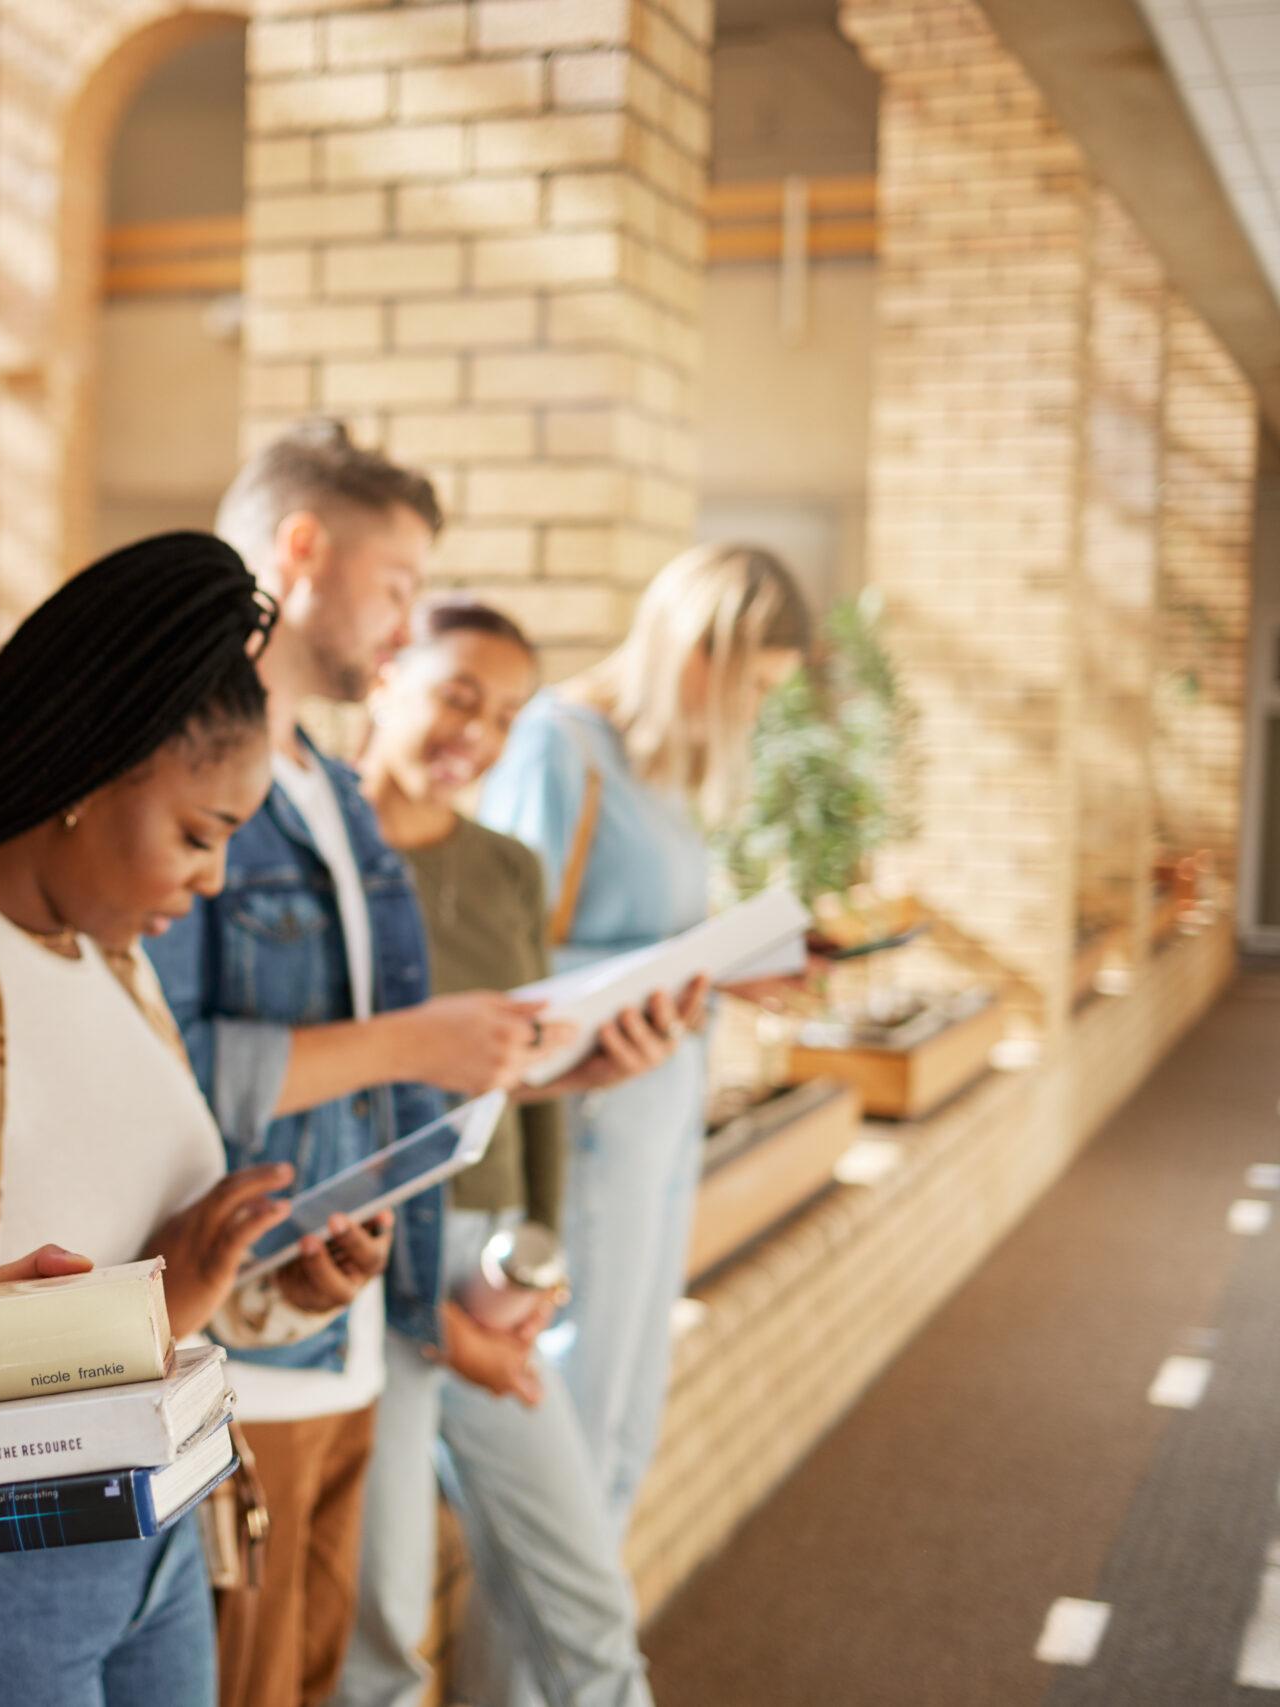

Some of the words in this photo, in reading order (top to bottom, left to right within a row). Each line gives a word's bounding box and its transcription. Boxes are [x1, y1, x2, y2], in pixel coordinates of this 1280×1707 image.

[31, 1371, 70, 1386] nicole
[78, 1363, 124, 1380] frankie
[21, 1438, 83, 1457] RESOURCE
[8, 1488, 59, 1503] Forecasting
